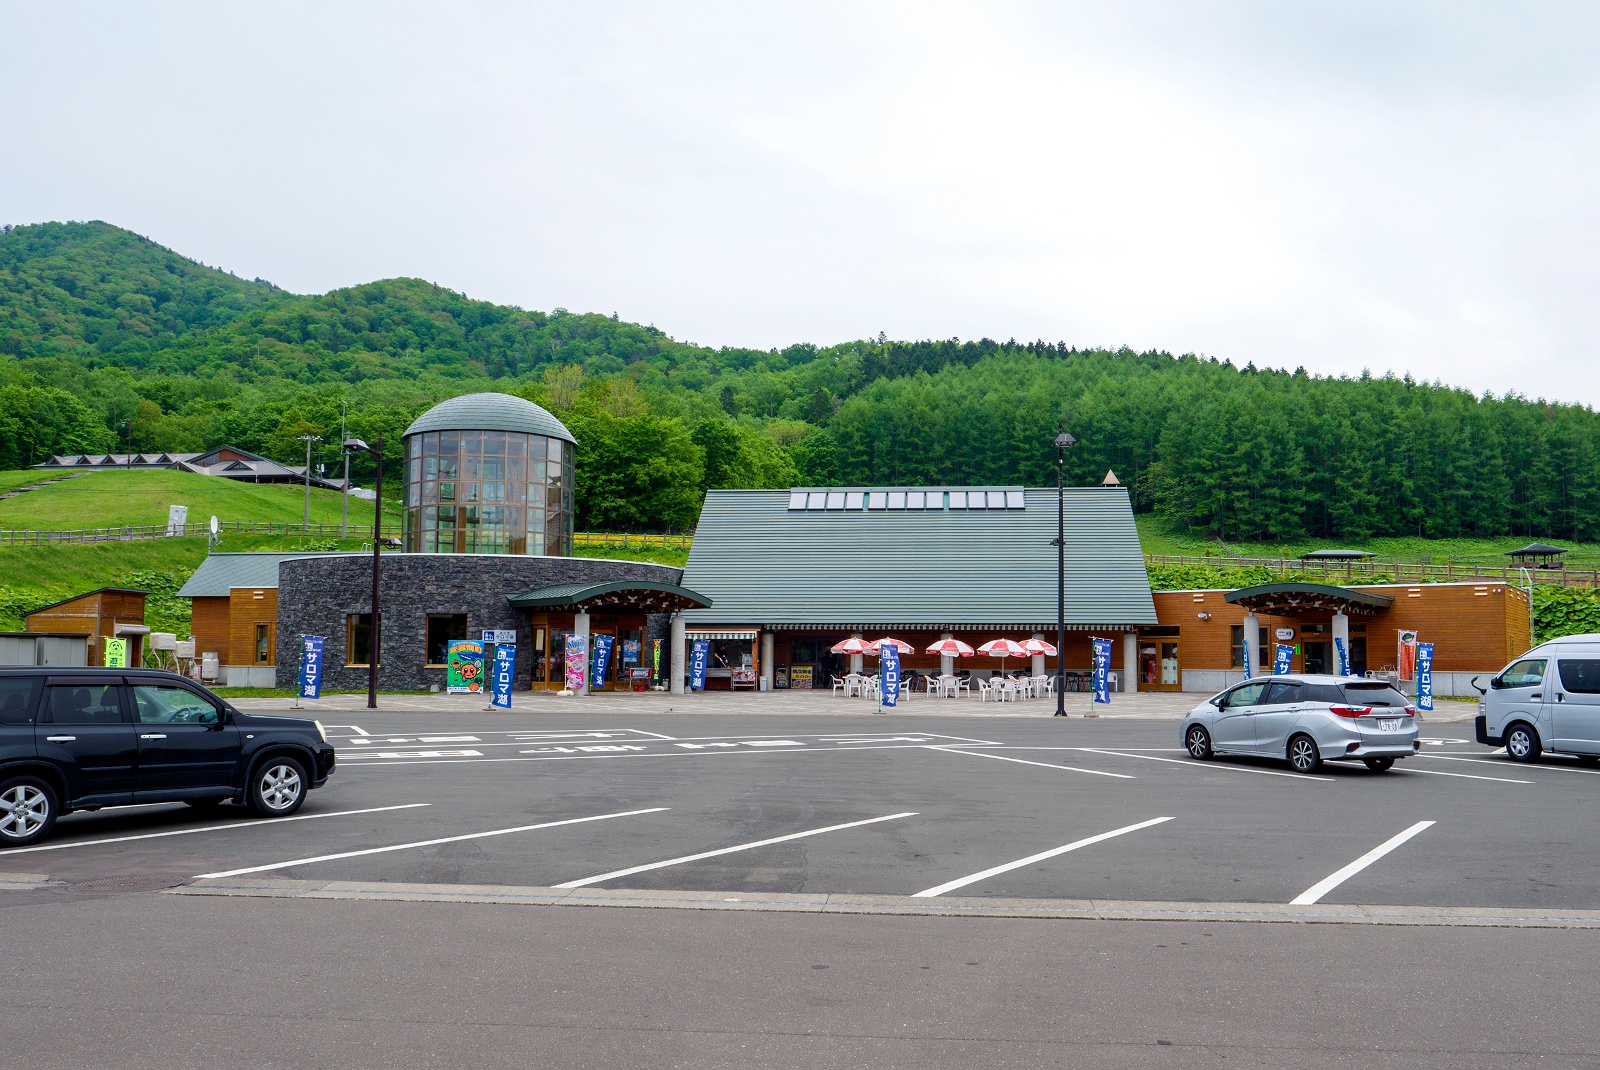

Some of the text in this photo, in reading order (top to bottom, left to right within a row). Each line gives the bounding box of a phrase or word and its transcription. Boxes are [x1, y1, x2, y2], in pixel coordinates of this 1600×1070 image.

[304, 652, 318, 696] サロマ湖
[497, 661, 510, 705] サロマ湖
[692, 652, 704, 687] サロマ湖
[1420, 661, 1432, 707] サロマ湖
